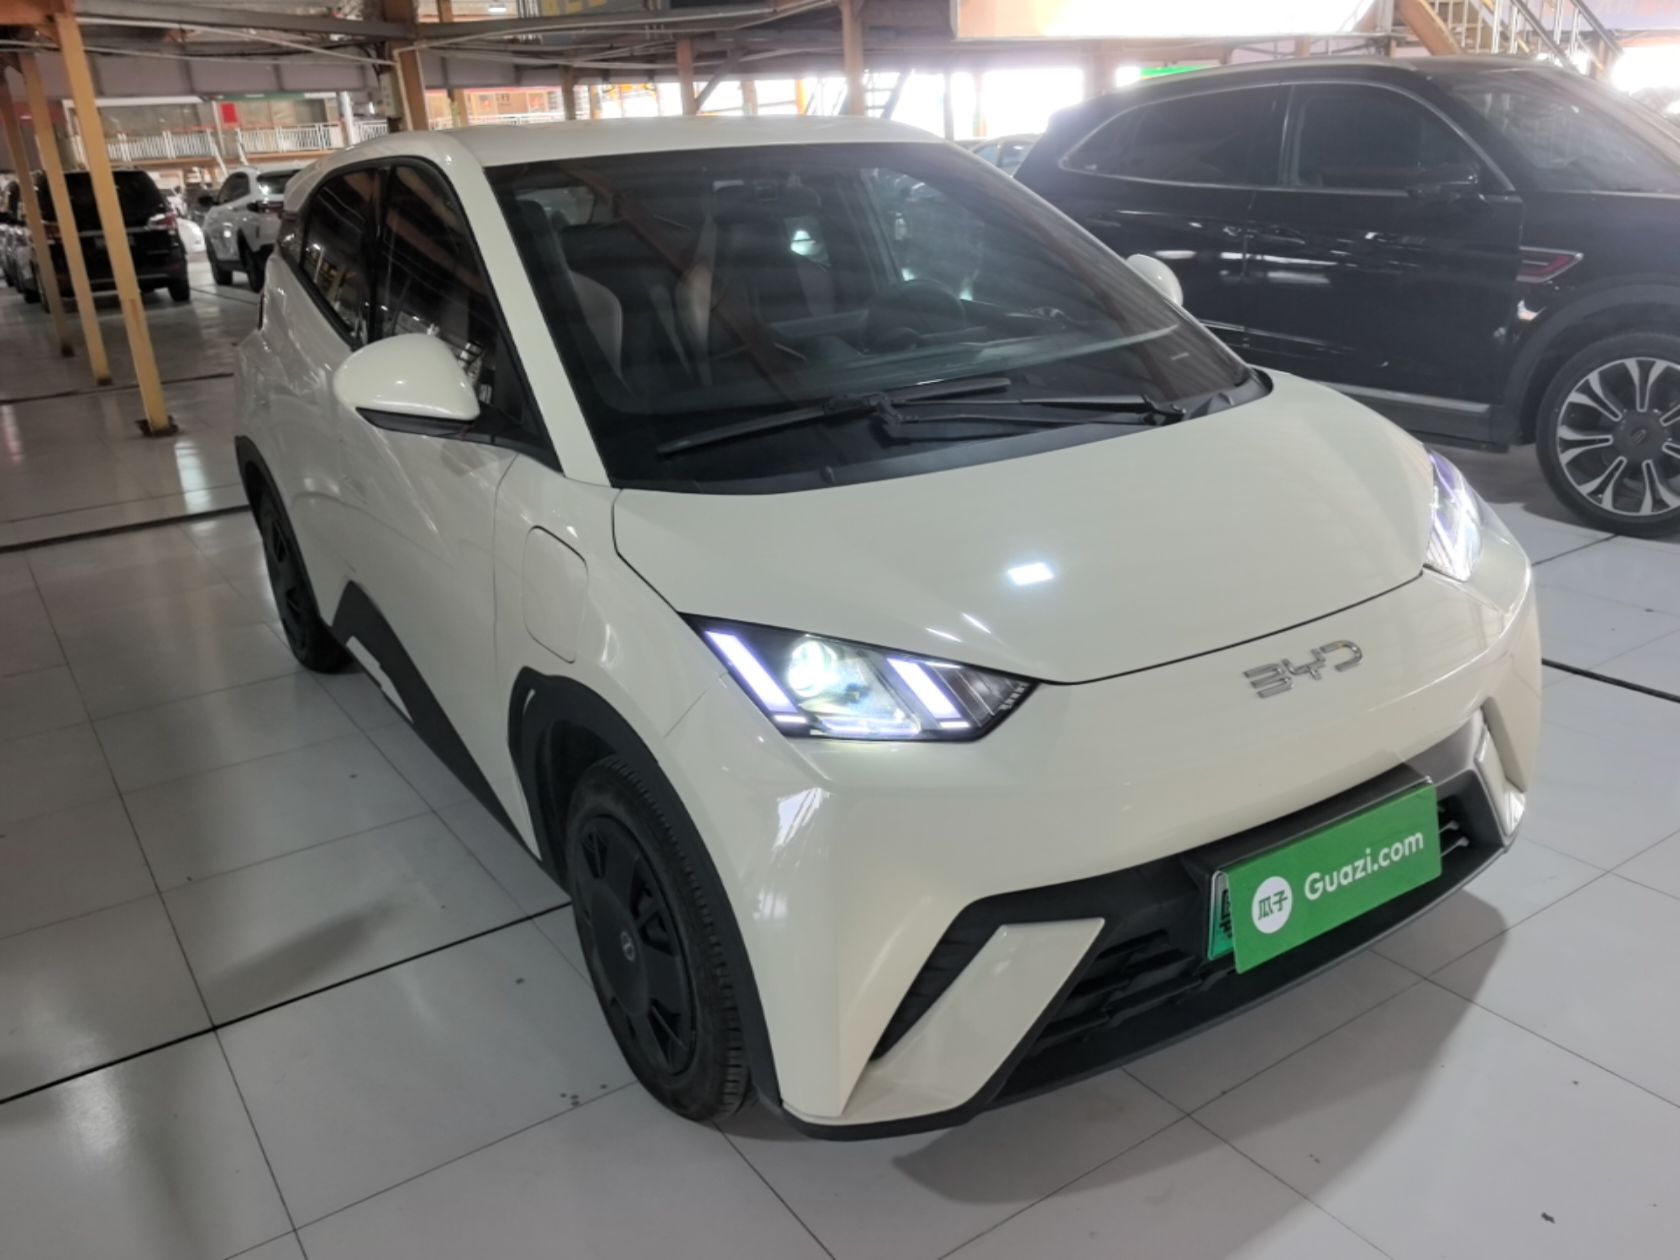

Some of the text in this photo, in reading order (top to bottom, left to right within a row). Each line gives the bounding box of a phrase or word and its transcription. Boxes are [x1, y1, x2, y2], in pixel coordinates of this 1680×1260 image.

[1242, 639, 1363, 699] BYD
[1304, 831, 1425, 901] Guazi.com
[1257, 889, 1289, 921] 瓜子
